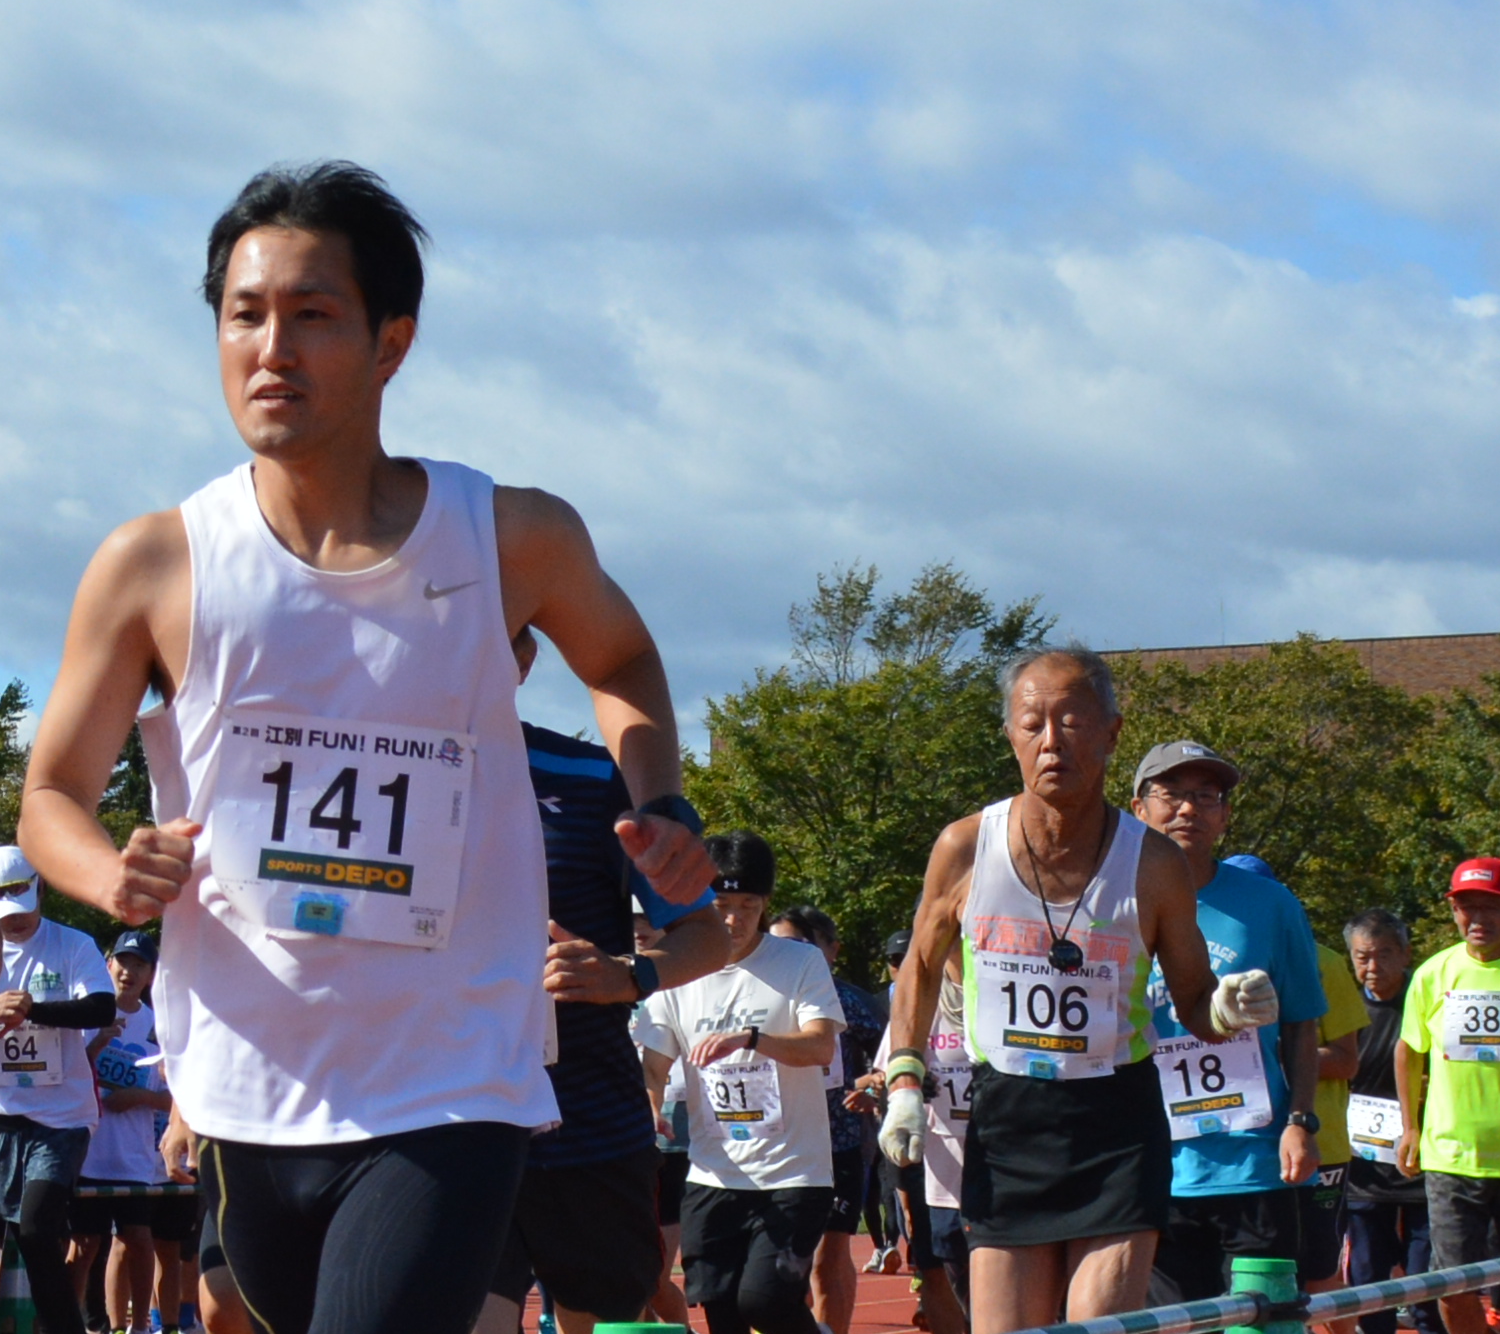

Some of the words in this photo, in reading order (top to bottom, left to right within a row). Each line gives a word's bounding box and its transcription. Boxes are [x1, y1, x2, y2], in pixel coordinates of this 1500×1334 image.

[265, 725, 303, 746] 江別
[308, 730, 365, 752] FUN!
[373, 737, 435, 760] RUN!
[262, 761, 410, 856] 141
[267, 858, 322, 875] SPORTS
[324, 862, 407, 889] DEPO
[1022, 963, 1054, 976] FUN!
[1001, 981, 1089, 1032] 106
[1464, 1006, 1500, 1033] 38
[4, 1035, 38, 1061] 64
[1039, 1038, 1085, 1050] DEPO
[1173, 1054, 1226, 1097] 18
[715, 1080, 747, 1109] 91
[1202, 1095, 1242, 1111] DEPO
[1368, 1112, 1384, 1134] 3
